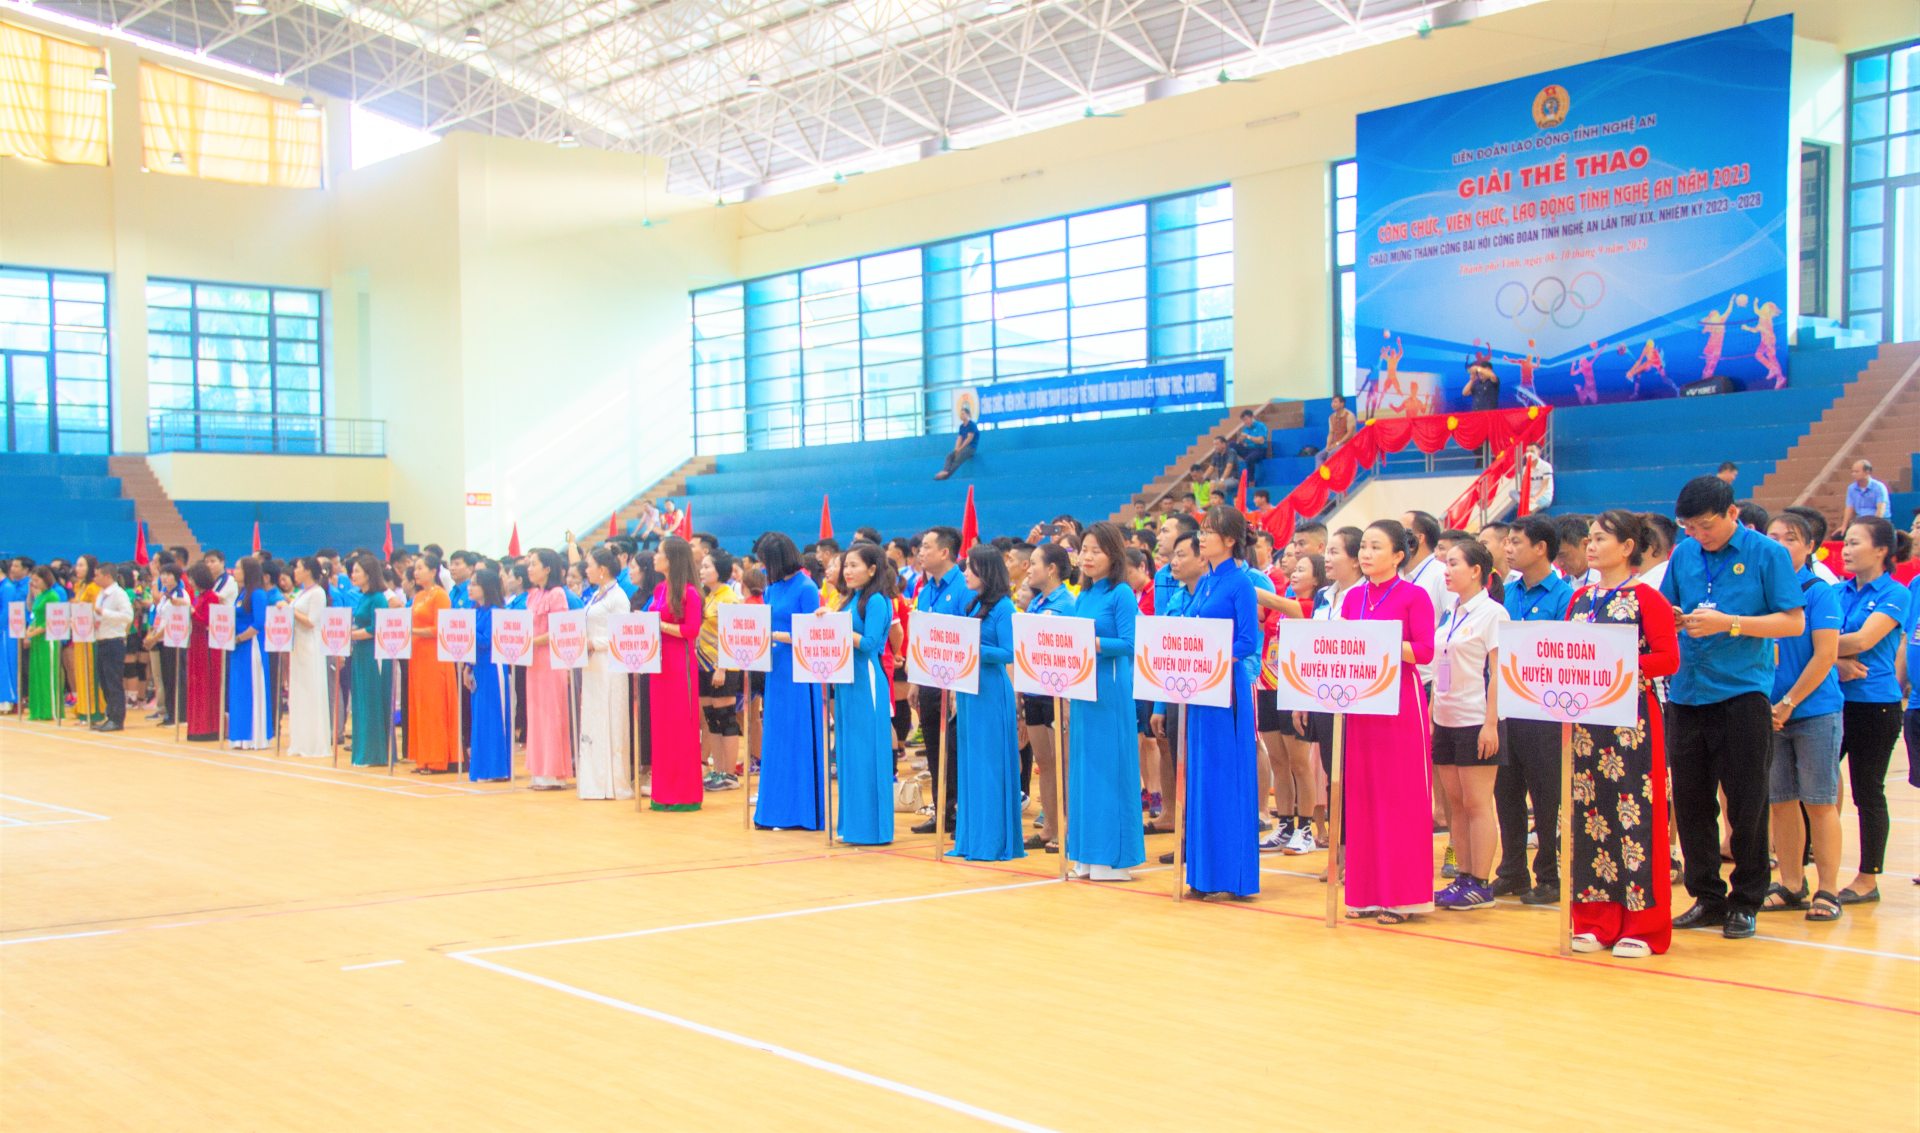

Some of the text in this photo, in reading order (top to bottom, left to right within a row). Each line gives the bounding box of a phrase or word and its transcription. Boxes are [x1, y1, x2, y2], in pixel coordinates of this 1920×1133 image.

[1452, 148, 1474, 165] LIÊN
[1476, 142, 1508, 159] ĐOÀN
[1511, 139, 1533, 153] LAO
[1535, 132, 1570, 151] ĐỘNG
[1602, 115, 1636, 135] NGHỆ
[1638, 113, 1656, 128] AN
[1458, 146, 1649, 199] GIẢI THỂ THAO
[1378, 221, 1408, 244] CÔNG
[1410, 215, 1443, 241] CHỨC,
[1446, 209, 1472, 234] VIÊN
[1475, 204, 1509, 228] CHỨC,
[1512, 201, 1537, 223] LAO
[1540, 193, 1575, 223] ĐỘNG
[1613, 177, 1650, 208] NGHỆ
[1653, 177, 1674, 202] AN
[1677, 168, 1709, 197] NĂM
[1712, 162, 1751, 190] 2023
[1413, 244, 1439, 260] THÀNH
[1440, 240, 1461, 256] CÔNG
[1462, 239, 1476, 255] ĐẠI
[1477, 235, 1491, 253] HỘI
[1492, 231, 1515, 248] CÔNG
[1516, 227, 1539, 244] ĐOÀN
[1561, 220, 1584, 238] NGHỆ
[1586, 219, 1599, 234] AN
[1620, 211, 1637, 228] THỨ
[1639, 210, 1656, 225] XIX,
[1659, 204, 1689, 223] NHIỆM
[1705, 198, 1728, 215] 2023
[1737, 193, 1761, 210] 2028
[1524, 253, 1543, 268] ngày
[1572, 245, 1596, 260] tháng
[1598, 244, 1604, 256] 9
[1605, 242, 1624, 255] năm
[1626, 237, 1647, 252] 2023
[622, 624, 645, 636] CÔNG ĐOÀN
[733, 617, 755, 631] CÔNG ĐOÀN
[810, 626, 835, 641] CÔNG ĐOÀN
[619, 639, 634, 653] HUYỆN
[753, 636, 761, 647] MAI
[930, 627, 960, 646] CÔNG ĐOÀN
[1037, 630, 1073, 649] CÔNG ĐOÀN
[1162, 633, 1204, 653] CÔNG ĐOÀN
[1314, 636, 1365, 656] CÔNG ĐOÀN
[804, 646, 812, 661] THỊ
[820, 644, 831, 658] THÁI
[923, 644, 941, 663] HUYỆN
[954, 650, 965, 667] HỢP
[1537, 638, 1596, 661] CÔNG ĐOÀN
[1031, 650, 1081, 670] HUYỆN ANH SƠN
[1153, 655, 1212, 677] HUYỆN QUỲ CHÂU
[1300, 660, 1377, 682] HUYỆN YÊN THÀNH
[1522, 664, 1611, 687] HUYỆN QUỲNH LƯU
